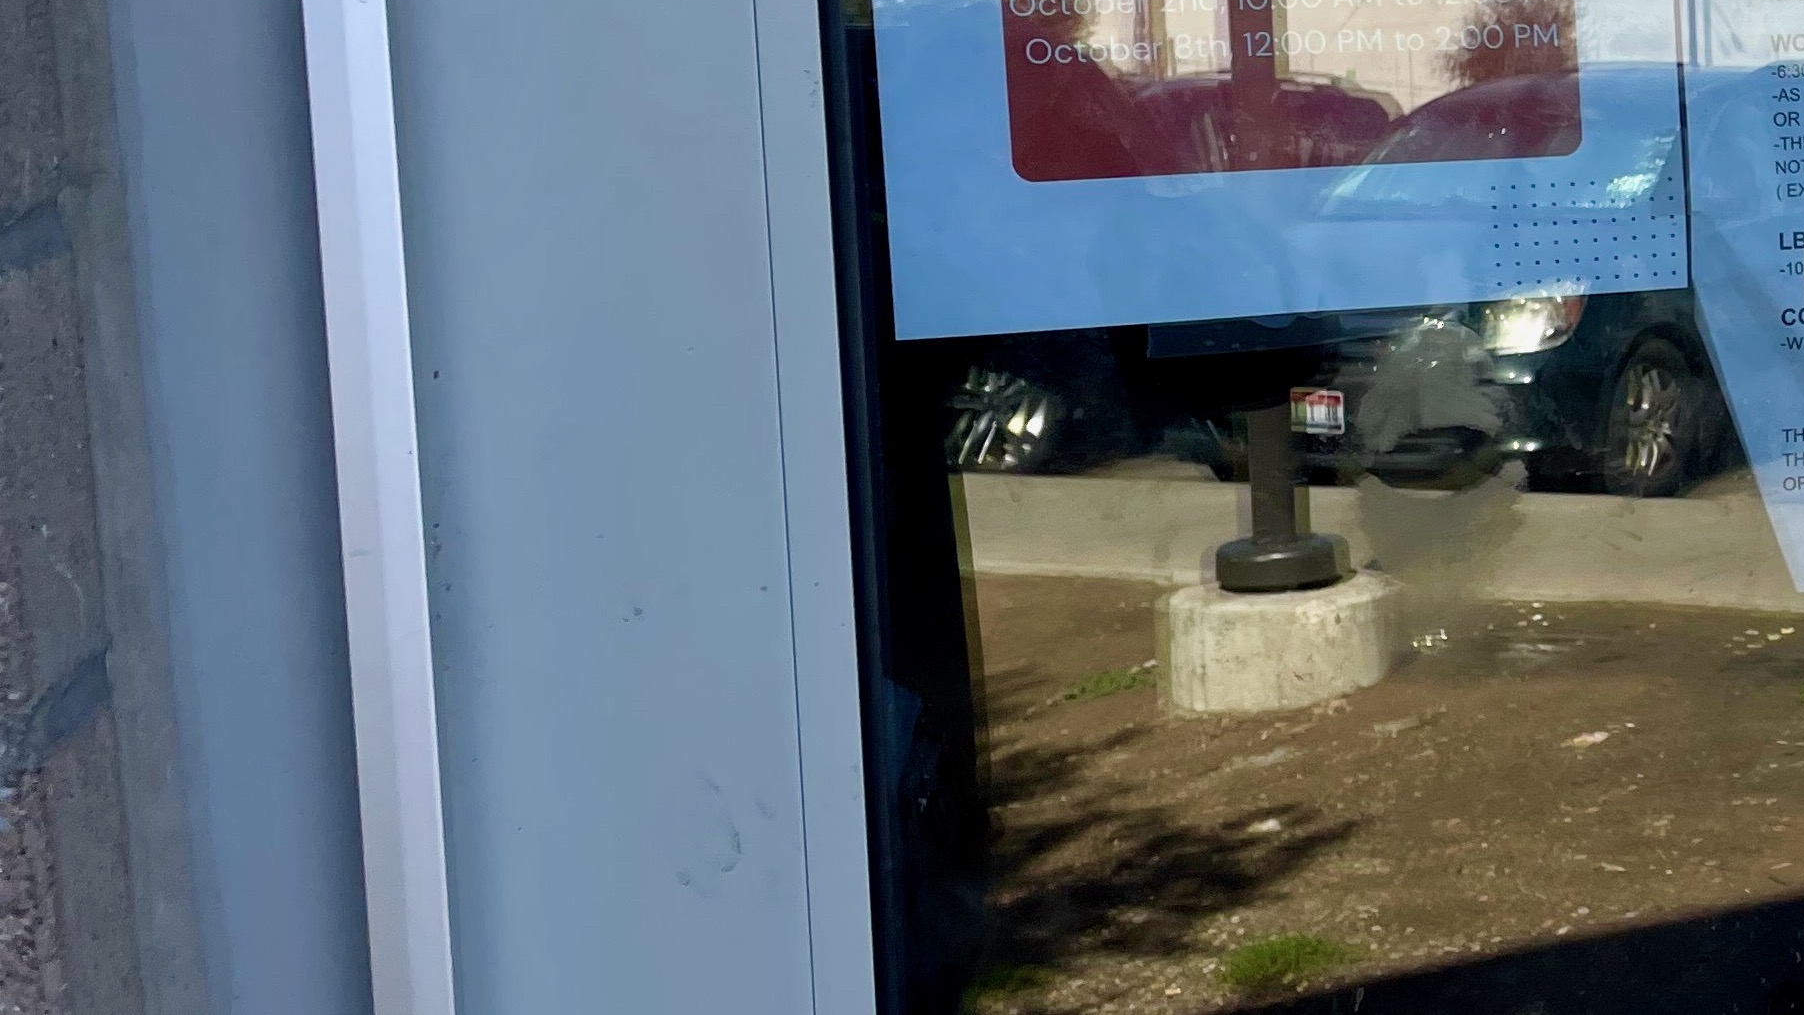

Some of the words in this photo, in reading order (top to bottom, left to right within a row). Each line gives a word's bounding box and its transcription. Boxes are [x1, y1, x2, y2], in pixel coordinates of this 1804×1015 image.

[1026, 38, 1163, 64] October
[1243, 31, 1326, 57] 12:00
[1337, 29, 1383, 53] PM
[1396, 33, 1424, 52] to
[1435, 25, 1503, 51] 2:00
[1514, 23, 1559, 48] PM
[1772, 87, 1800, 102] -AS
[1773, 112, 1800, 127] OR
